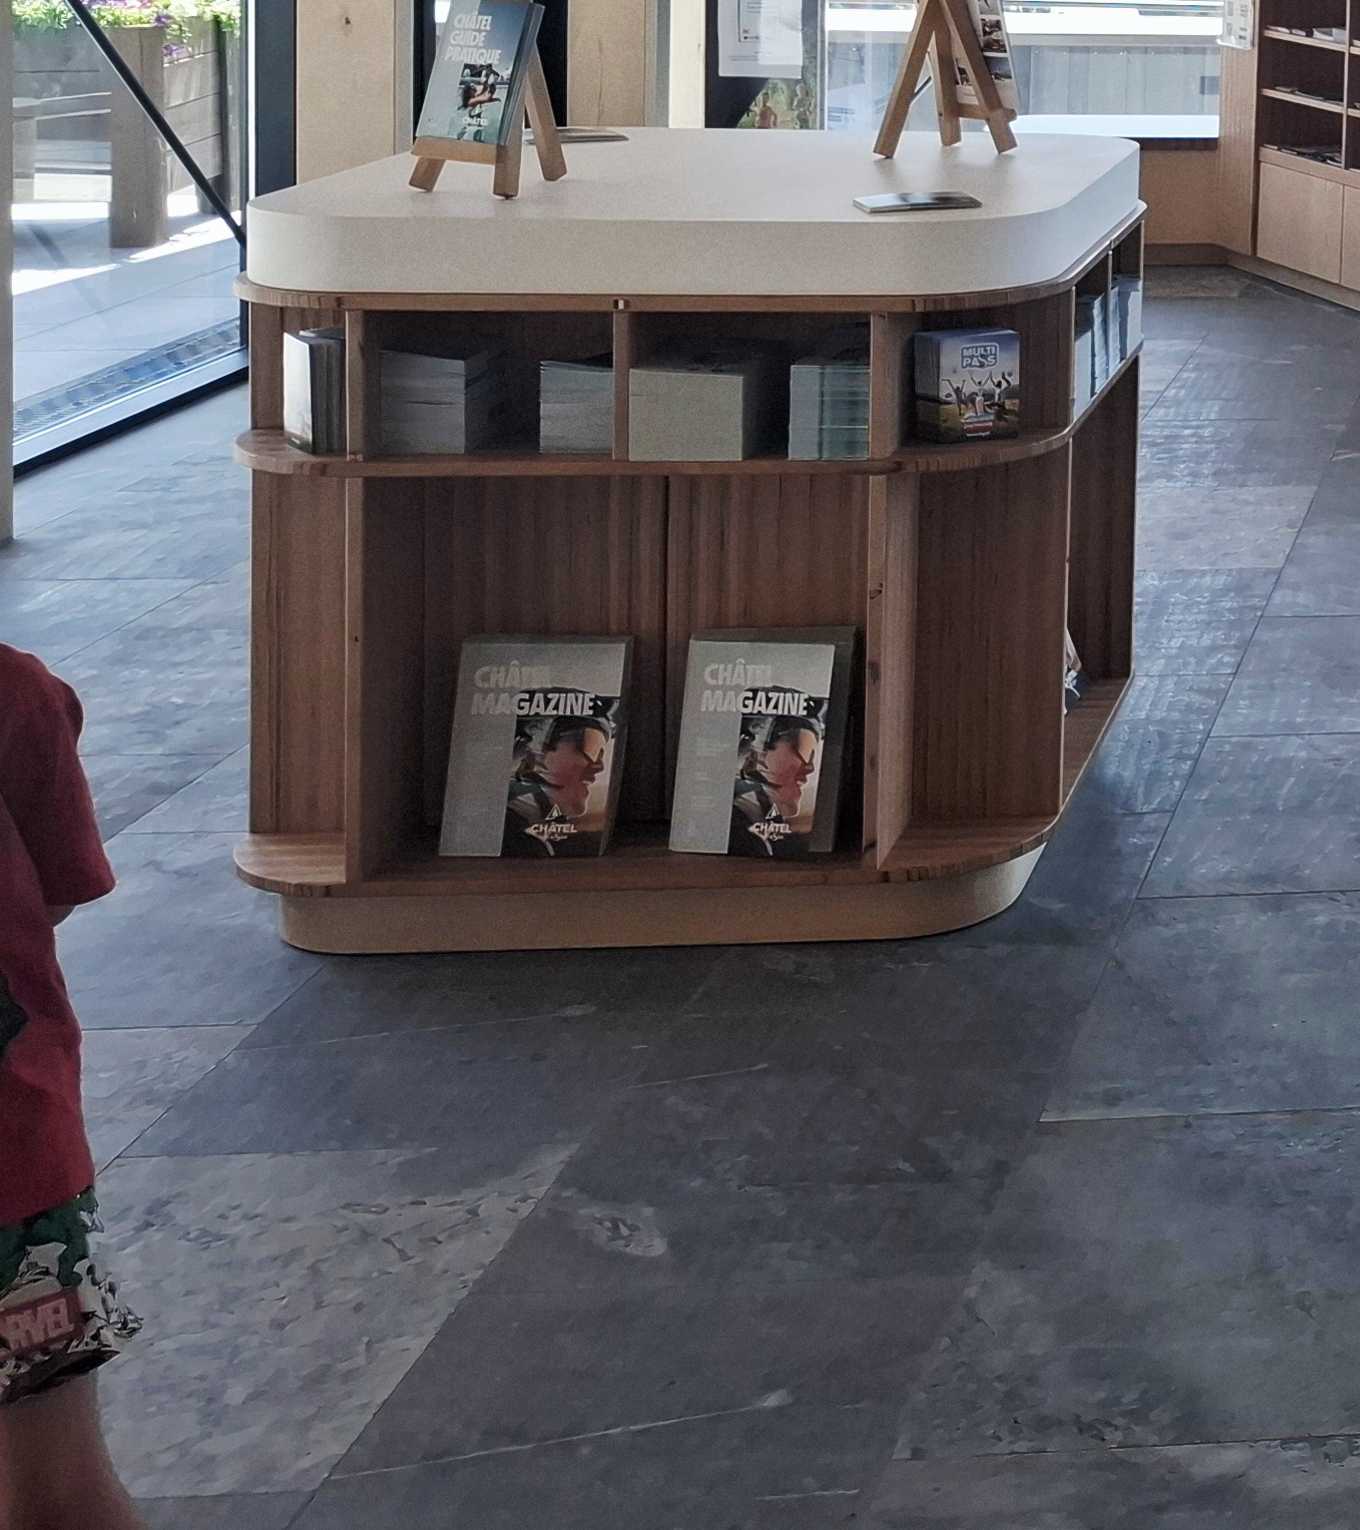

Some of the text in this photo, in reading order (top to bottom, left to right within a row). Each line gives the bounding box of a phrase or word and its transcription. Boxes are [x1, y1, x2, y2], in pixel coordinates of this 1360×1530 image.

[450, 30, 486, 46] GUIDE
[444, 45, 502, 65] PRATIQUE
[963, 346, 996, 358] MULTI
[963, 356, 996, 367] PASS
[470, 692, 595, 717] MAGAZINE
[700, 689, 809, 716] MAGAZINE
[0, 1298, 75, 1351] RVEL
